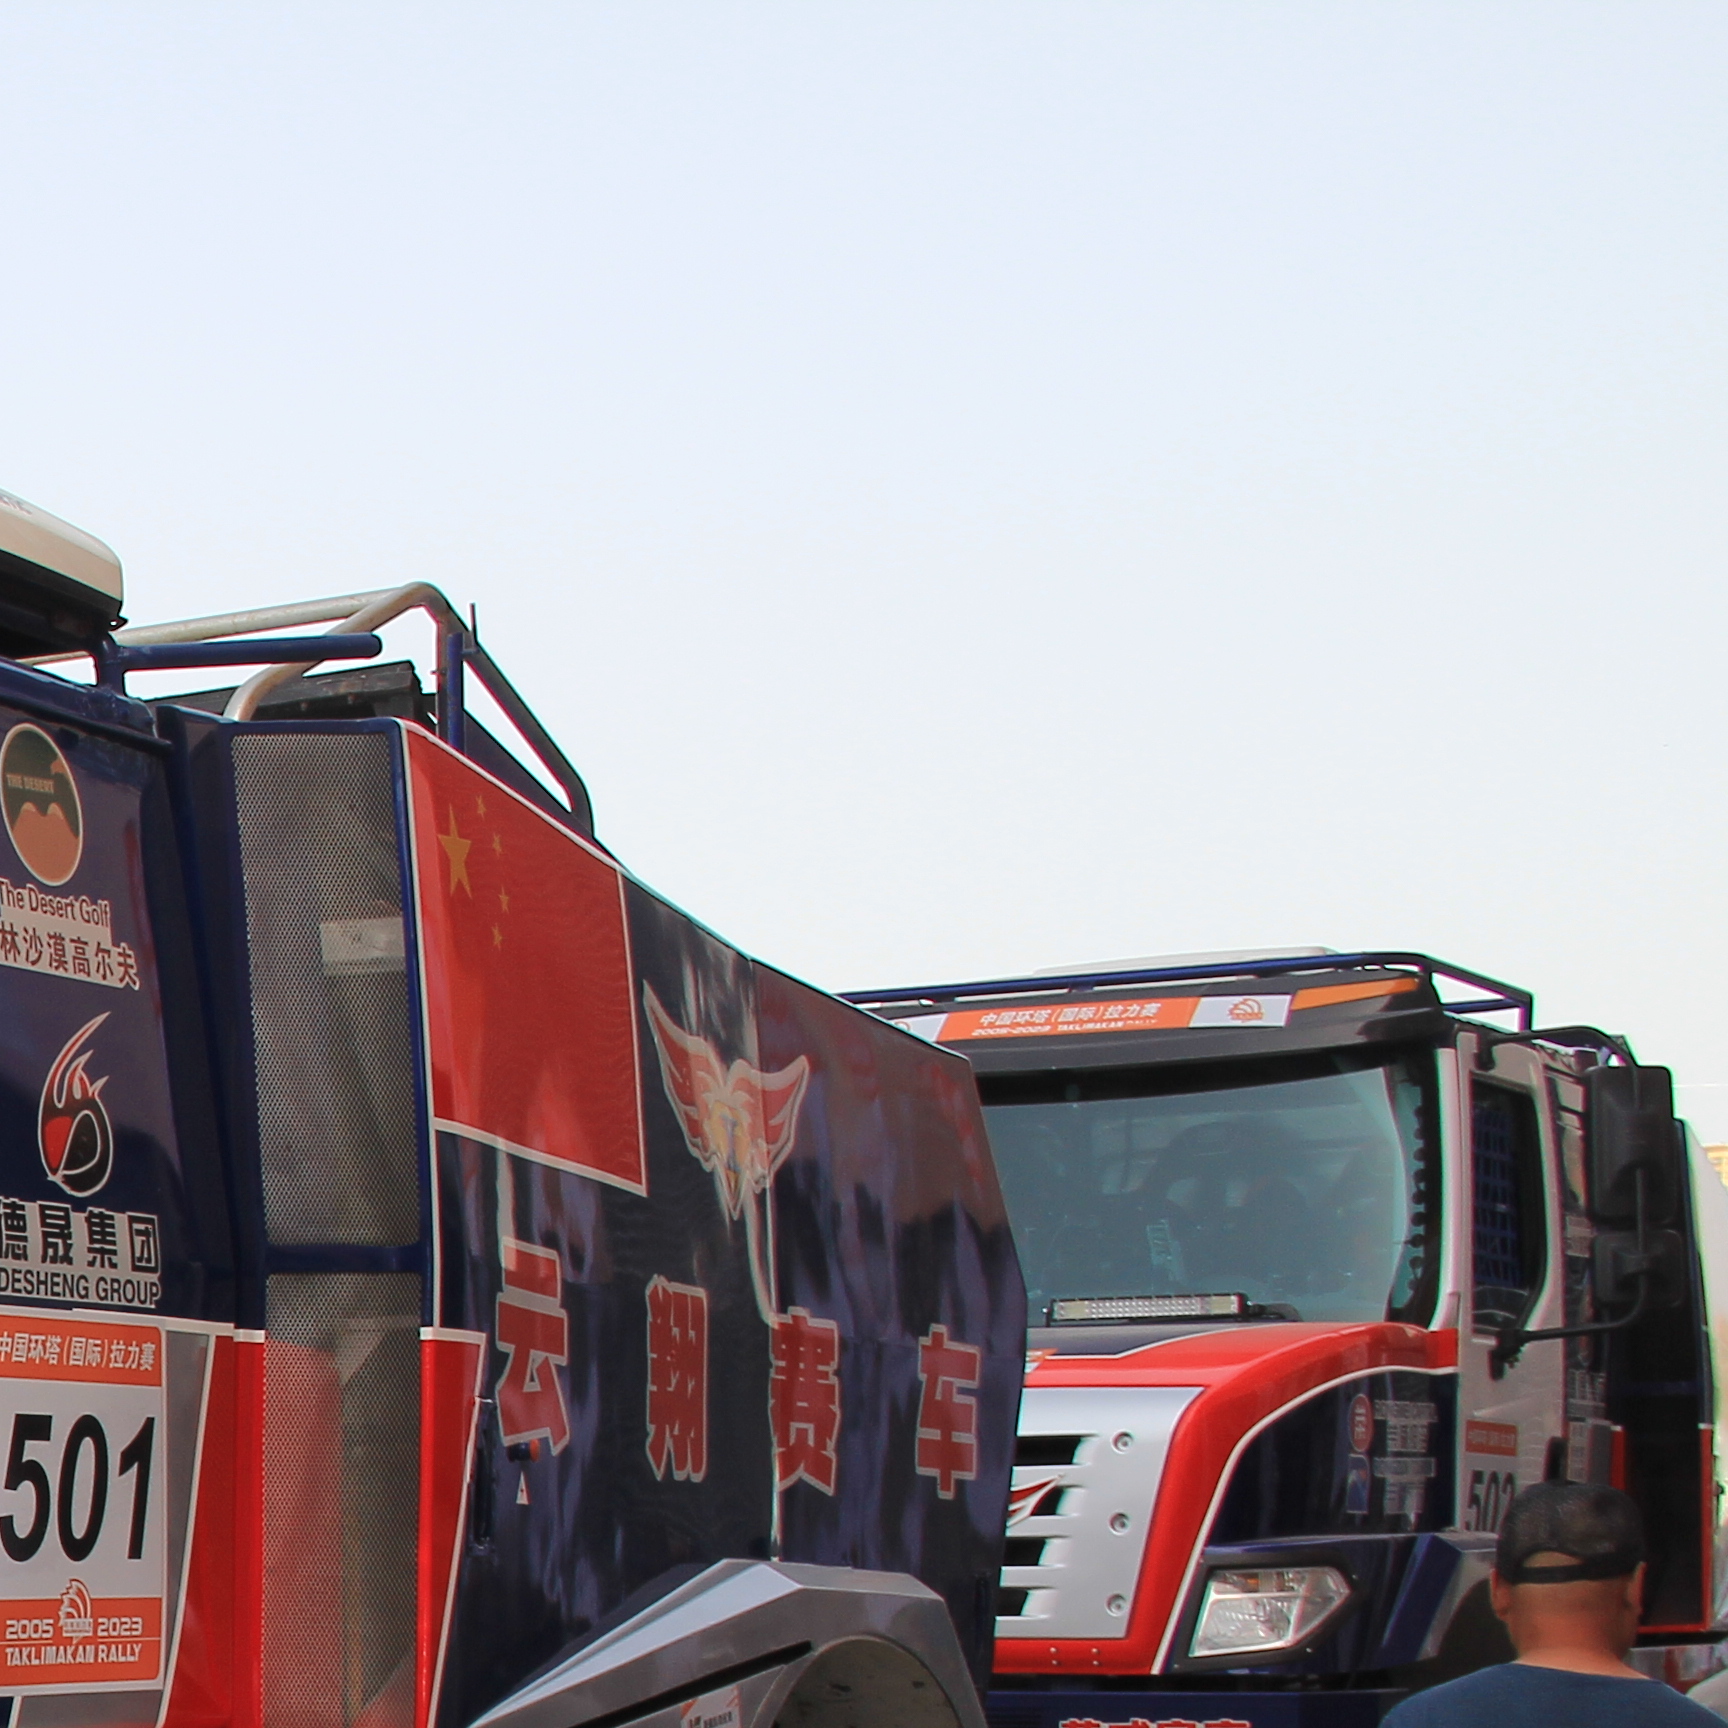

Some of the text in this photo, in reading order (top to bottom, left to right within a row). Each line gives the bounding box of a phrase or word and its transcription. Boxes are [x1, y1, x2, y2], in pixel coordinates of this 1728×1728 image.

[28, 888, 76, 923] Desert
[79, 895, 111, 928] Golf
[95, 1276, 161, 1305] GROUP
[494, 1235, 984, 1502] 云翔赛车
[5, 1618, 55, 1641] 2005
[96, 1616, 144, 1637] 2023
[5, 1643, 143, 1667] TAKLIMAKAN RALLY
